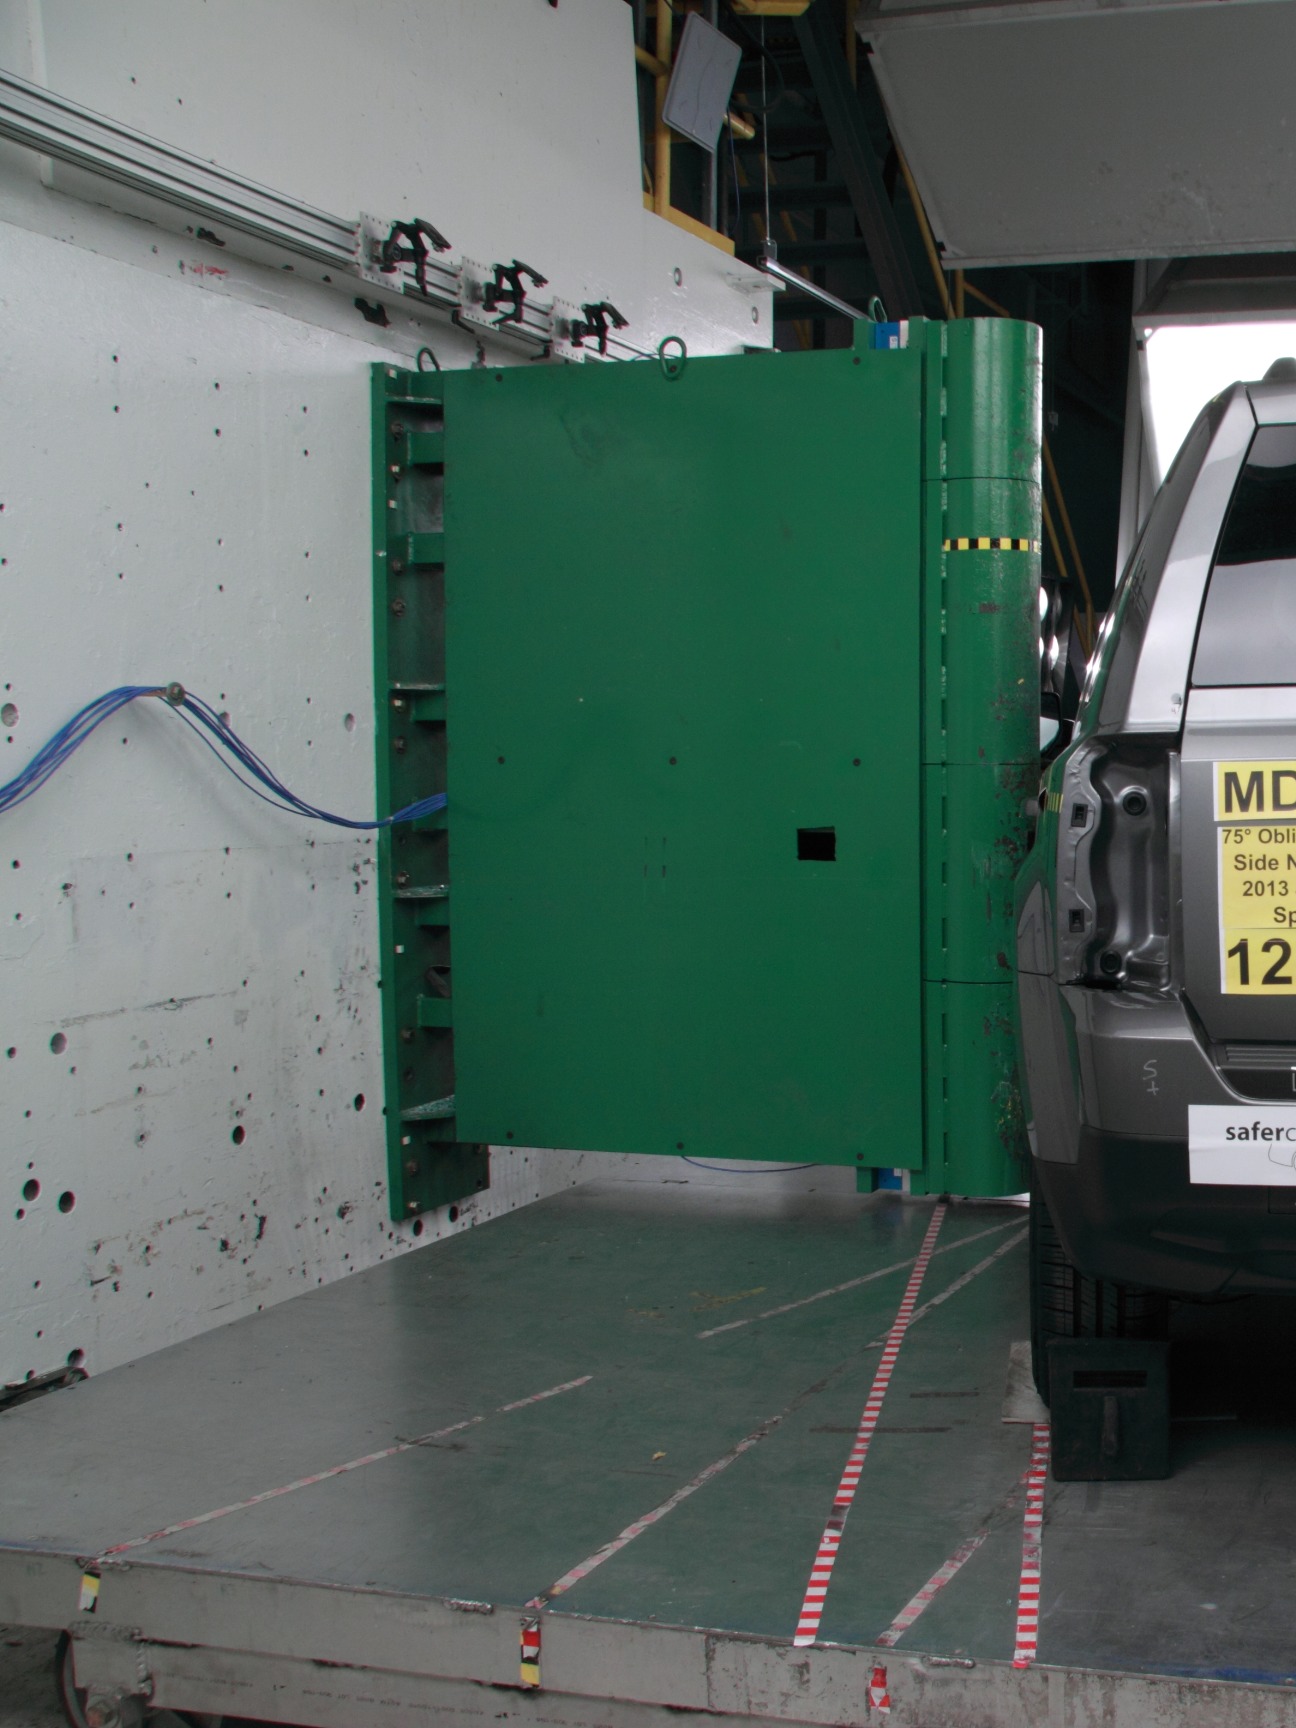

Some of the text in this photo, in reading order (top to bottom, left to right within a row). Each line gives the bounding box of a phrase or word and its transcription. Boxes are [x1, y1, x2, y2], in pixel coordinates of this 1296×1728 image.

[1222, 828, 1251, 844] 75°
[1234, 854, 1279, 871] Side
[1242, 880, 1289, 897] 2013
